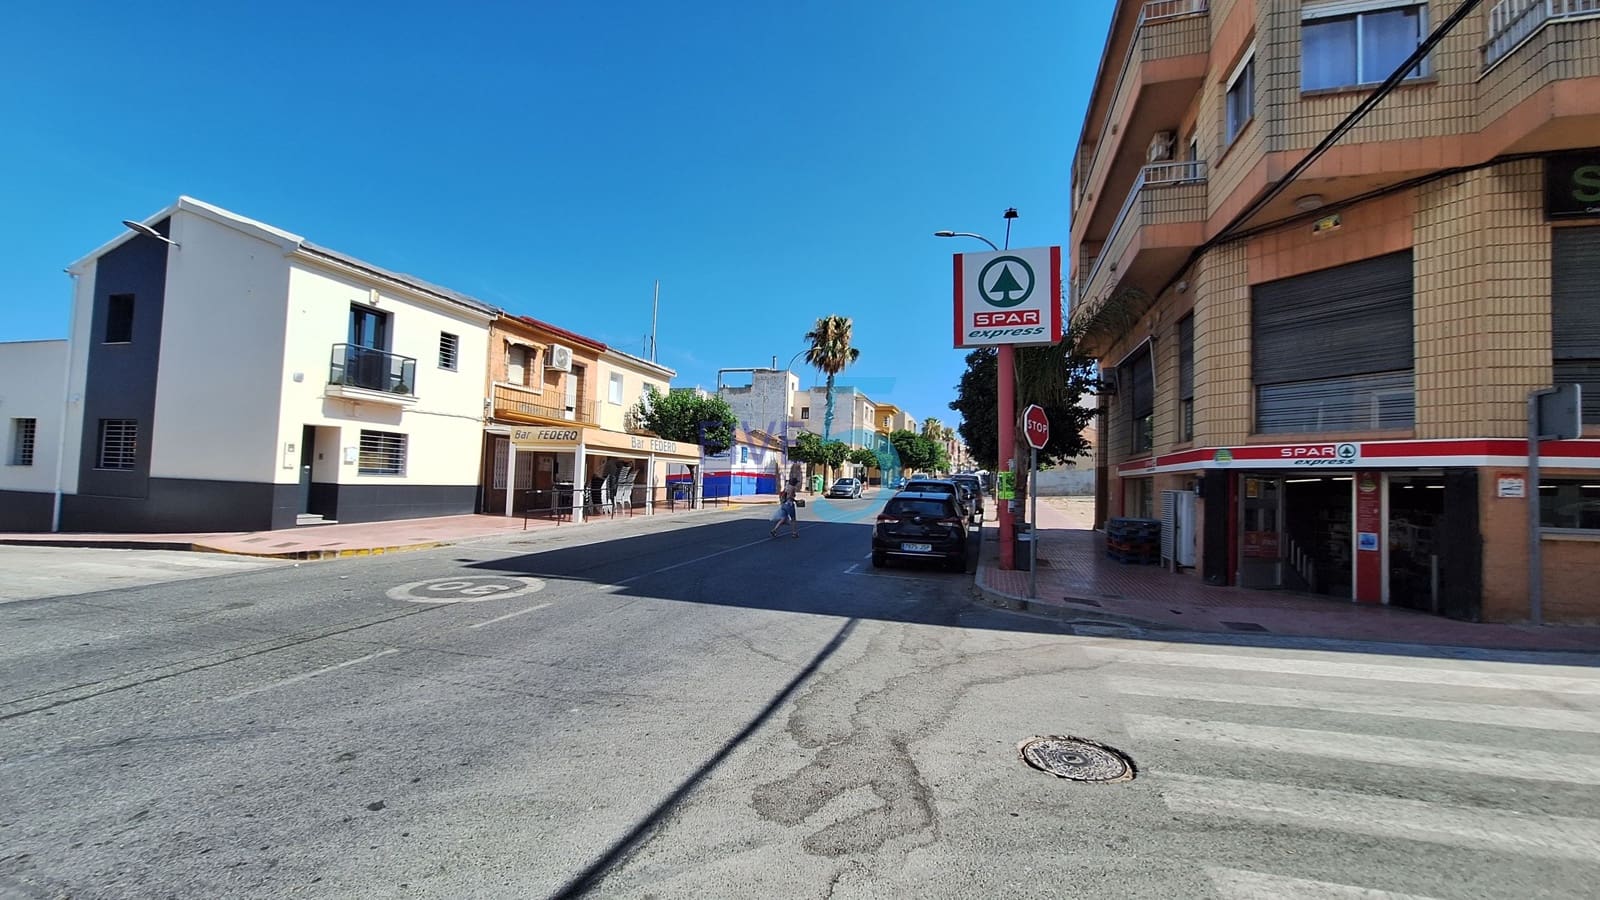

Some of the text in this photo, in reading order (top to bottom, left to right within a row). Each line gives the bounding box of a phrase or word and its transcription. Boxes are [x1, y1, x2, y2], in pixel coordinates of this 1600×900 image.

[975, 311, 1038, 325] SPAR
[968, 327, 1045, 339] express
[1028, 419, 1047, 433] STOP
[515, 430, 578, 440] Bar FEDERO
[631, 437, 677, 453] Bar FEDERO
[1280, 446, 1335, 458] SPAR
[1294, 458, 1356, 466] express
